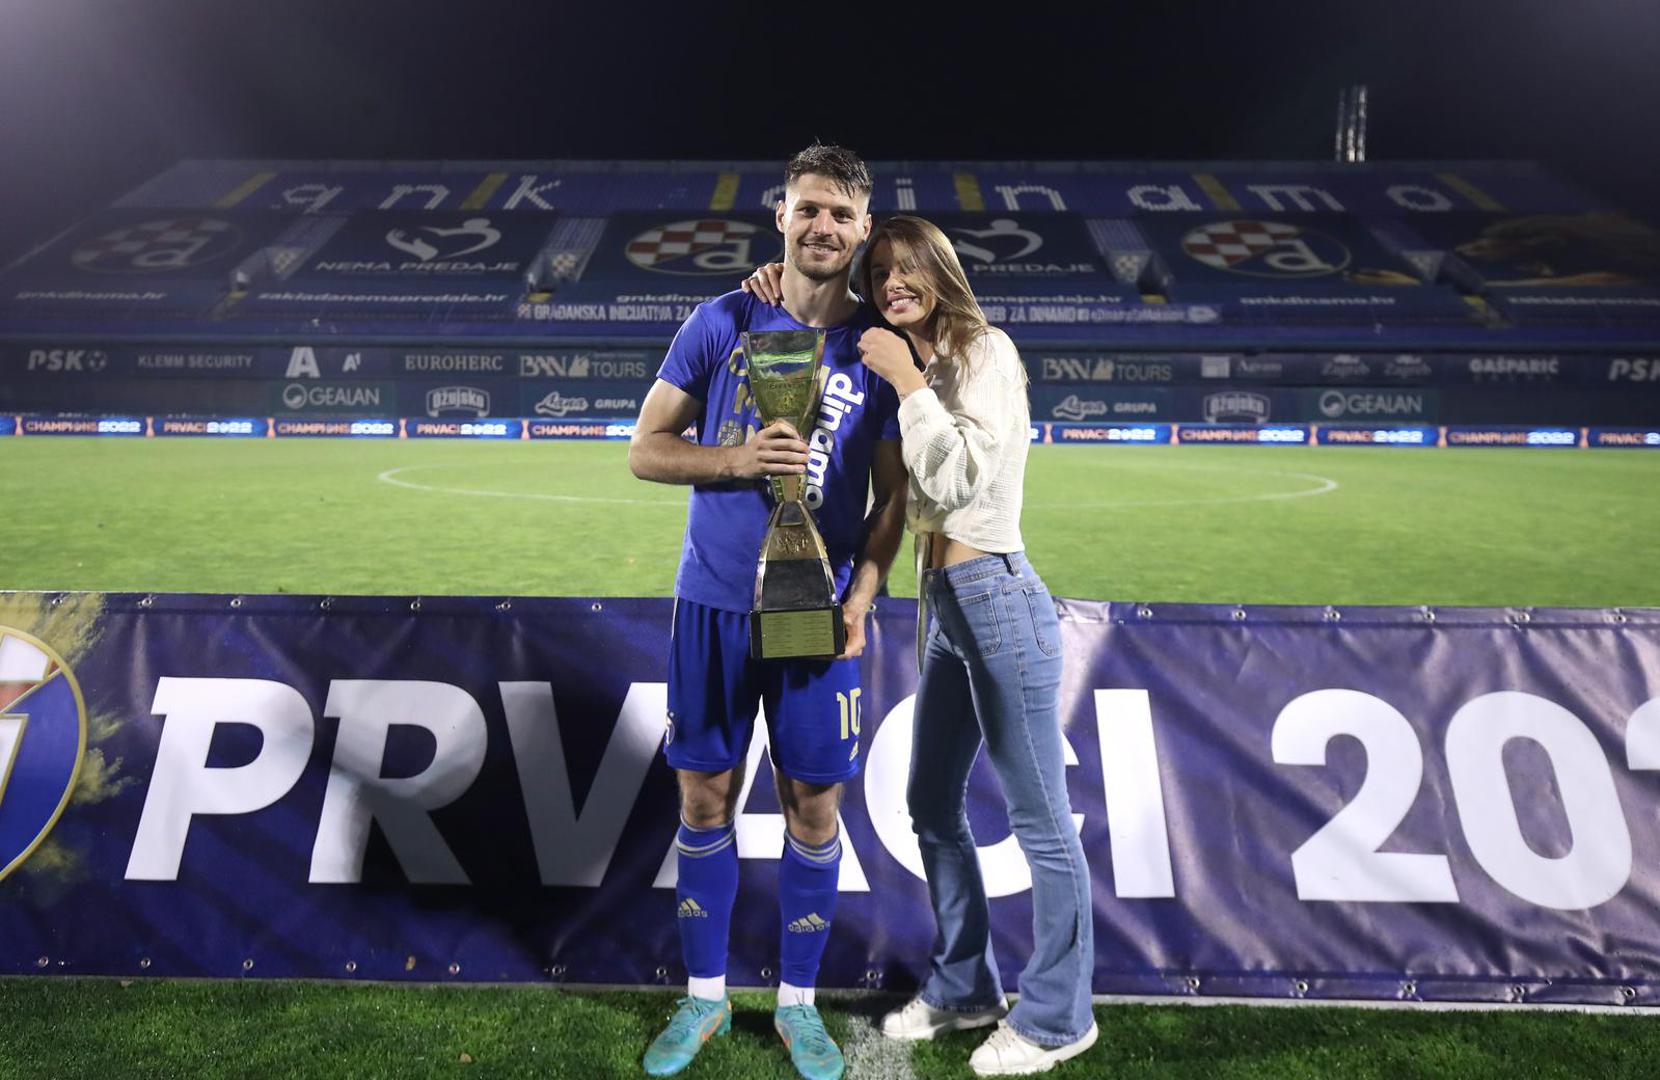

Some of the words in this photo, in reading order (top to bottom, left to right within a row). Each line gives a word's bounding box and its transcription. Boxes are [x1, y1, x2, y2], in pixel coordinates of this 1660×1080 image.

[400, 261, 519, 271] PREDAJE
[973, 262, 1096, 273] PREDAJE
[27, 349, 86, 371] PSK
[138, 355, 185, 368] KLEMM
[188, 355, 253, 368] SECURITY
[405, 355, 503, 371] EUROHERC
[592, 361, 646, 378] TOURS
[1117, 365, 1171, 381] TOURS
[309, 388, 379, 406] GEALAN
[594, 399, 636, 409] GRUPA
[1347, 393, 1421, 414] GEALAN
[804, 372, 865, 511] dinamo
[1271, 688, 1660, 911] 20
